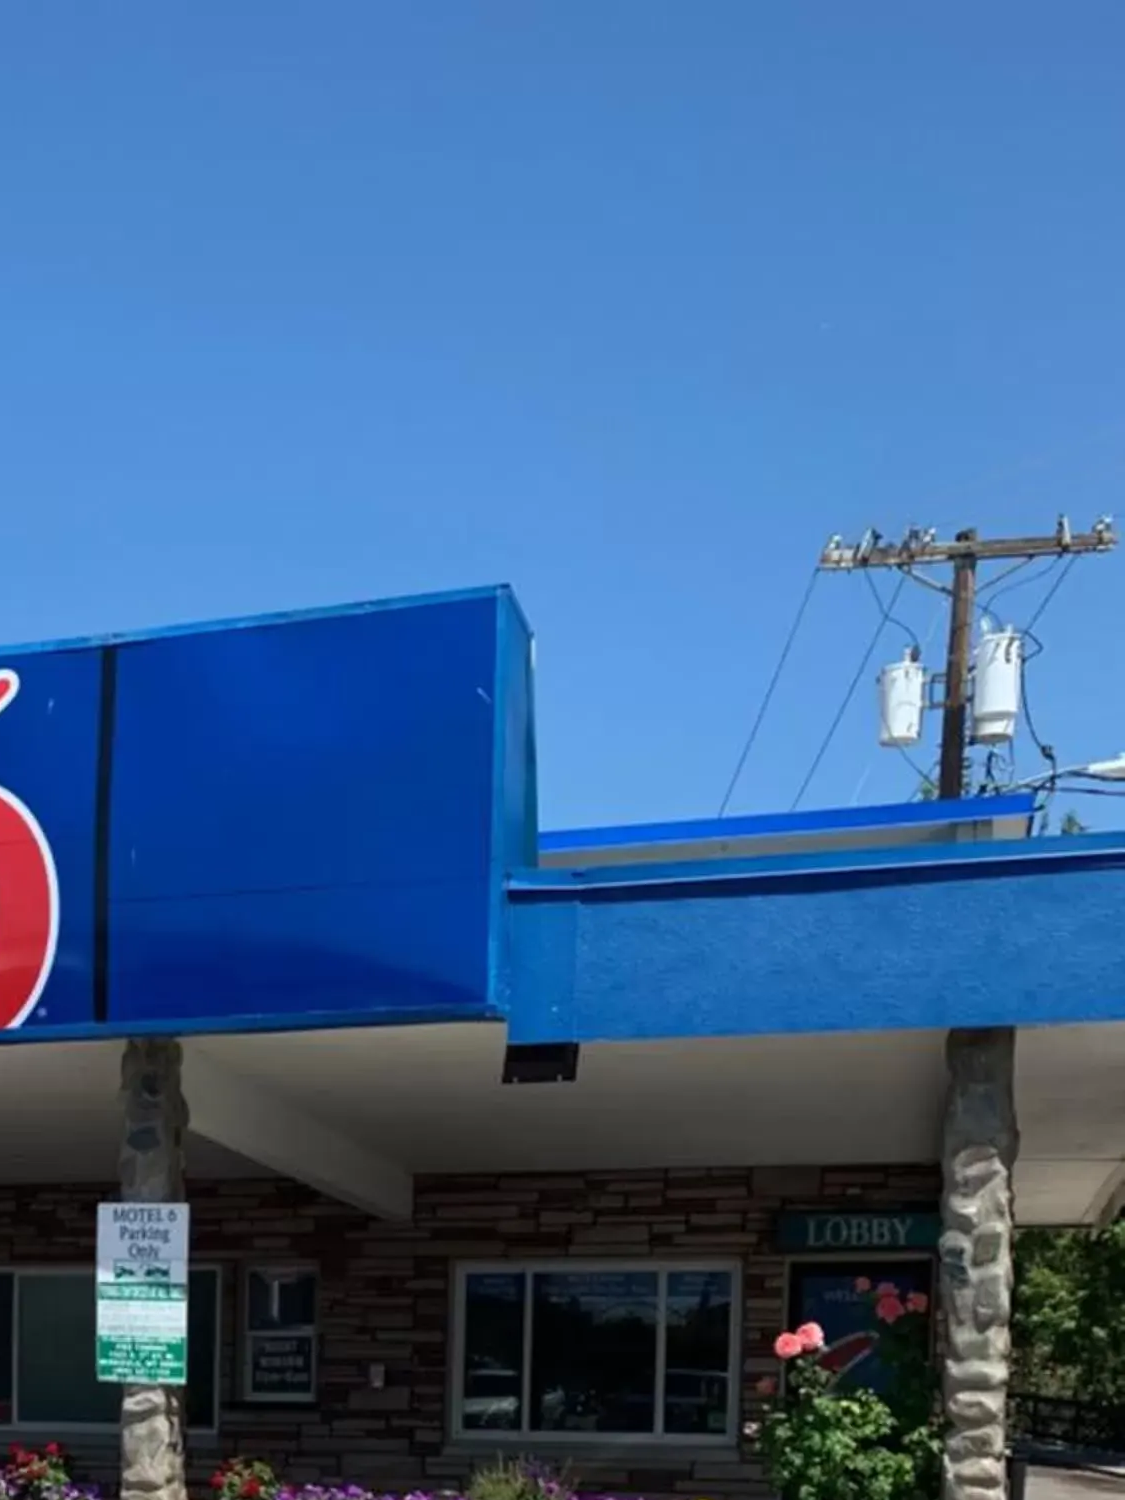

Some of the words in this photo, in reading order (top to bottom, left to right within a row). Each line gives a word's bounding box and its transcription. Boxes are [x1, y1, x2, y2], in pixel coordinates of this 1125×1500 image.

[113, 1207, 163, 1223] MOTEL
[166, 1208, 178, 1223] 6
[119, 1225, 171, 1244] Parking
[805, 1216, 913, 1246] LOBBY
[127, 1243, 160, 1260] Only
